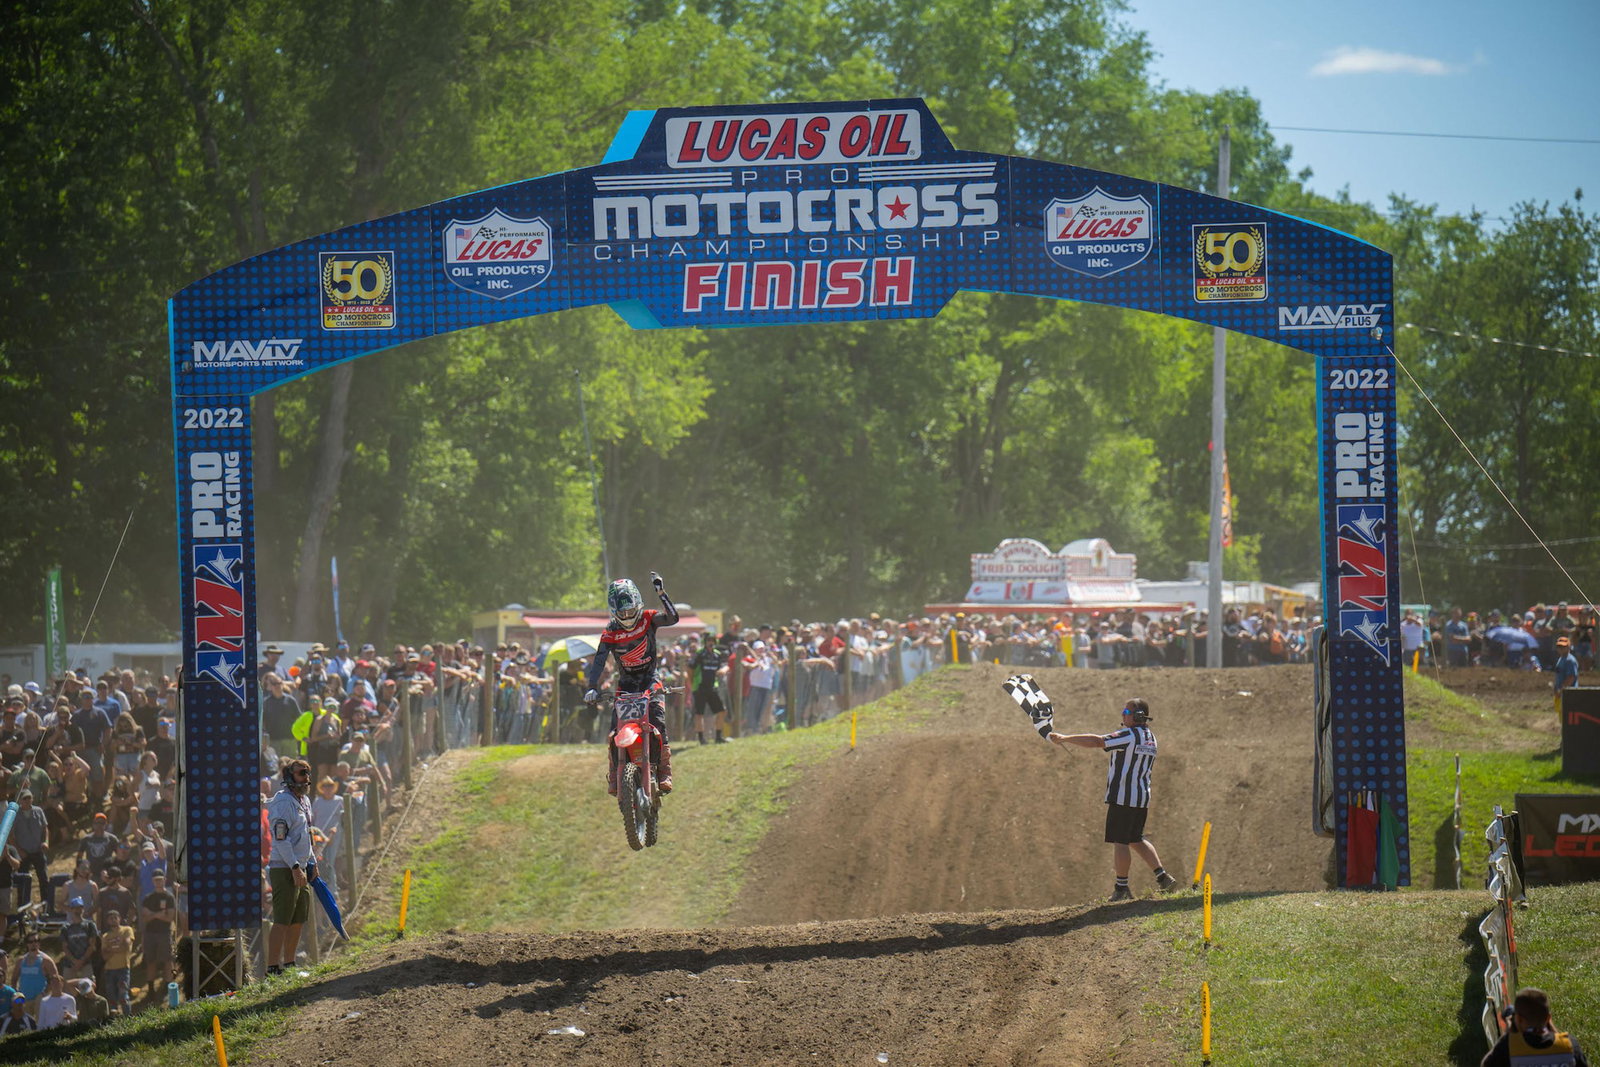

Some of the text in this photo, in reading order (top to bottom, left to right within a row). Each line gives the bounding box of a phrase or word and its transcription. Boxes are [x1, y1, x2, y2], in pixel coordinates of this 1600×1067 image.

[677, 114, 911, 163] LUCAS OIL
[741, 168, 849, 186] PRO
[593, 182, 998, 240] MOTOCROSS
[1057, 217, 1143, 239] LUCAS
[457, 239, 542, 260] LUCAS
[594, 230, 1000, 260] CHAMPIONSHIP
[1052, 243, 1145, 255] OIL PRODUCTS
[1205, 232, 1258, 272] 50
[452, 265, 545, 277] OIL PRODUCTS
[1087, 259, 1113, 267] INC.
[332, 260, 386, 300] 50
[487, 280, 513, 289] INC.
[682, 256, 915, 312] FINISH
[1344, 316, 1372, 326] PLUS
[1330, 369, 1389, 389] 2022
[184, 408, 243, 428] 2022
[1335, 412, 1367, 498] PRO
[1369, 412, 1385, 497] RACING
[190, 452, 224, 538] PRO
[224, 452, 242, 537] RACING
[982, 564, 1060, 573] FRIED DOUGH
[1336, 504, 1390, 667] AMA
[193, 544, 246, 708] AMA
[620, 702, 646, 720] 23
